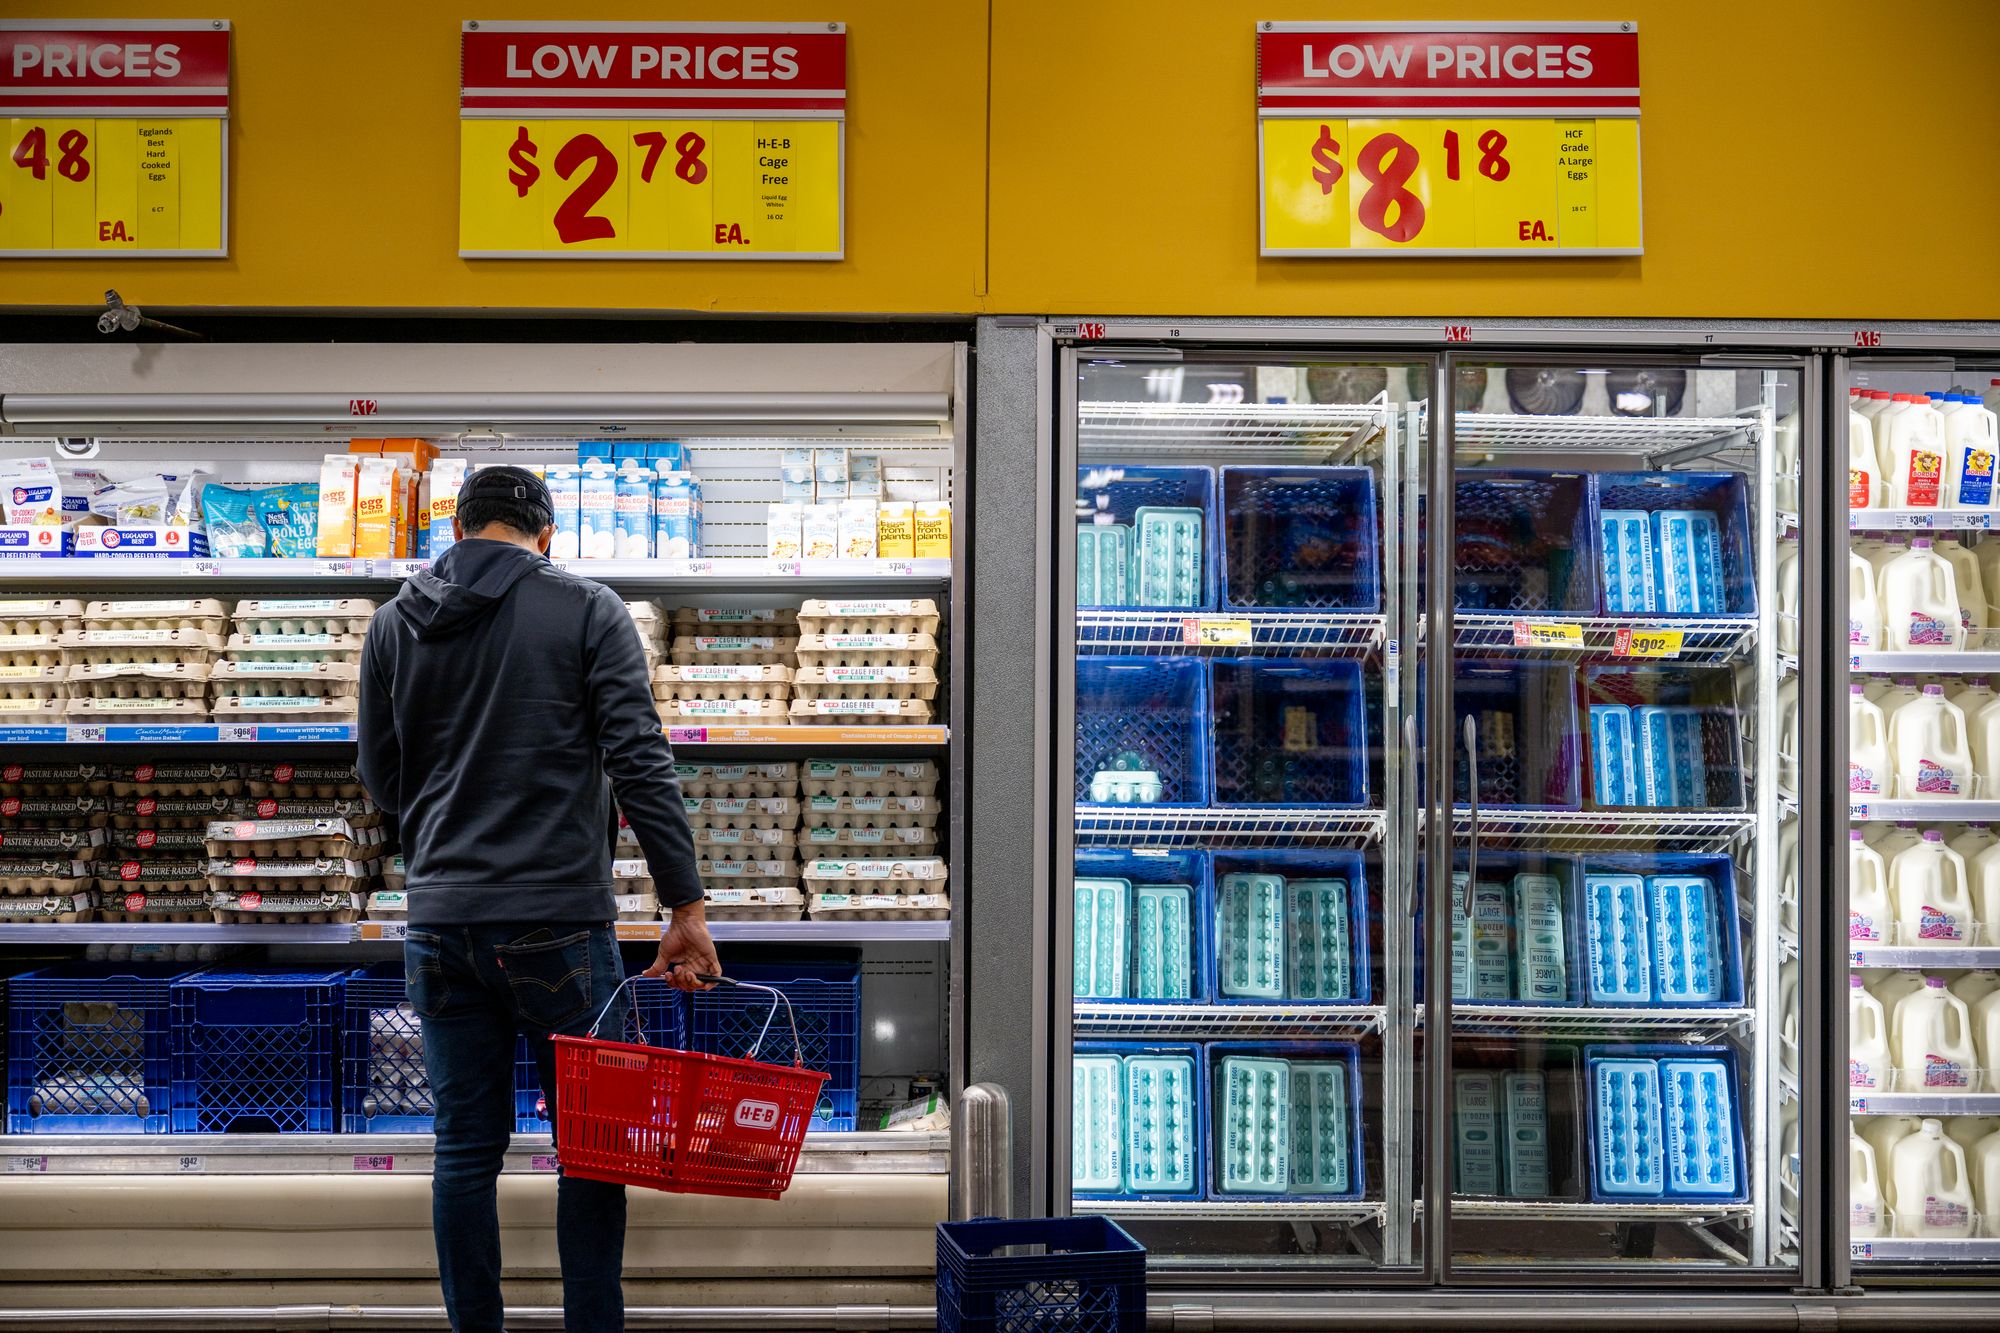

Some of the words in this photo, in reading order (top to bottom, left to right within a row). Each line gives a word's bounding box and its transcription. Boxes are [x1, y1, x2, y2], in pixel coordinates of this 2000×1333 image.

[12, 43, 181, 78] PRICES
[506, 45, 618, 79] LOW
[631, 45, 799, 80] PRICES
[1303, 45, 1413, 79] LOW
[1427, 45, 1594, 79] PRICES
[138, 127, 173, 137] Egglands
[1565, 130, 1583, 139] HCF
[147, 139, 165, 148] Best
[757, 138, 790, 149] H-E-B
[1561, 143, 1589, 153] Grade
[146, 150, 166, 159] Hard
[141, 161, 171, 170] Cooked
[759, 156, 788, 170] Cage
[1559, 156, 1565, 166] A
[1567, 156, 1593, 167] Large
[148, 172, 167, 183] Eggs
[762, 174, 788, 185] Free
[1567, 170, 1588, 181] Eggs
[761, 194, 776, 202] Liquid
[778, 194, 787, 202] Egg
[99, 221, 135, 243] EA.
[715, 223, 750, 244] EA.
[1519, 220, 1554, 242] EA.
[1079, 323, 1105, 338] A13
[1170, 329, 1180, 337] 18
[1446, 326, 1471, 341] A14
[1855, 332, 1881, 346] A15
[351, 400, 377, 415] A12
[322, 490, 346, 502] egg
[360, 498, 383, 510] egg
[432, 498, 456, 511] egg
[1910, 516, 1926, 525] $368
[1967, 516, 1983, 525] $368
[329, 563, 346, 572] $496
[406, 564, 422, 573] $496
[1620, 632, 1630, 653] PRICES
[1632, 638, 1665, 653] $902
[81, 729, 99, 737] $928
[233, 728, 251, 738] $968
[1480, 908, 1500, 917] LARGE
[1536, 969, 1556, 978] LARGE
[1466, 1097, 1487, 1106] LARGE
[1518, 1098, 1540, 1107] LARGE
[180, 1157, 198, 1168] $942
[369, 1157, 386, 1167] $628
